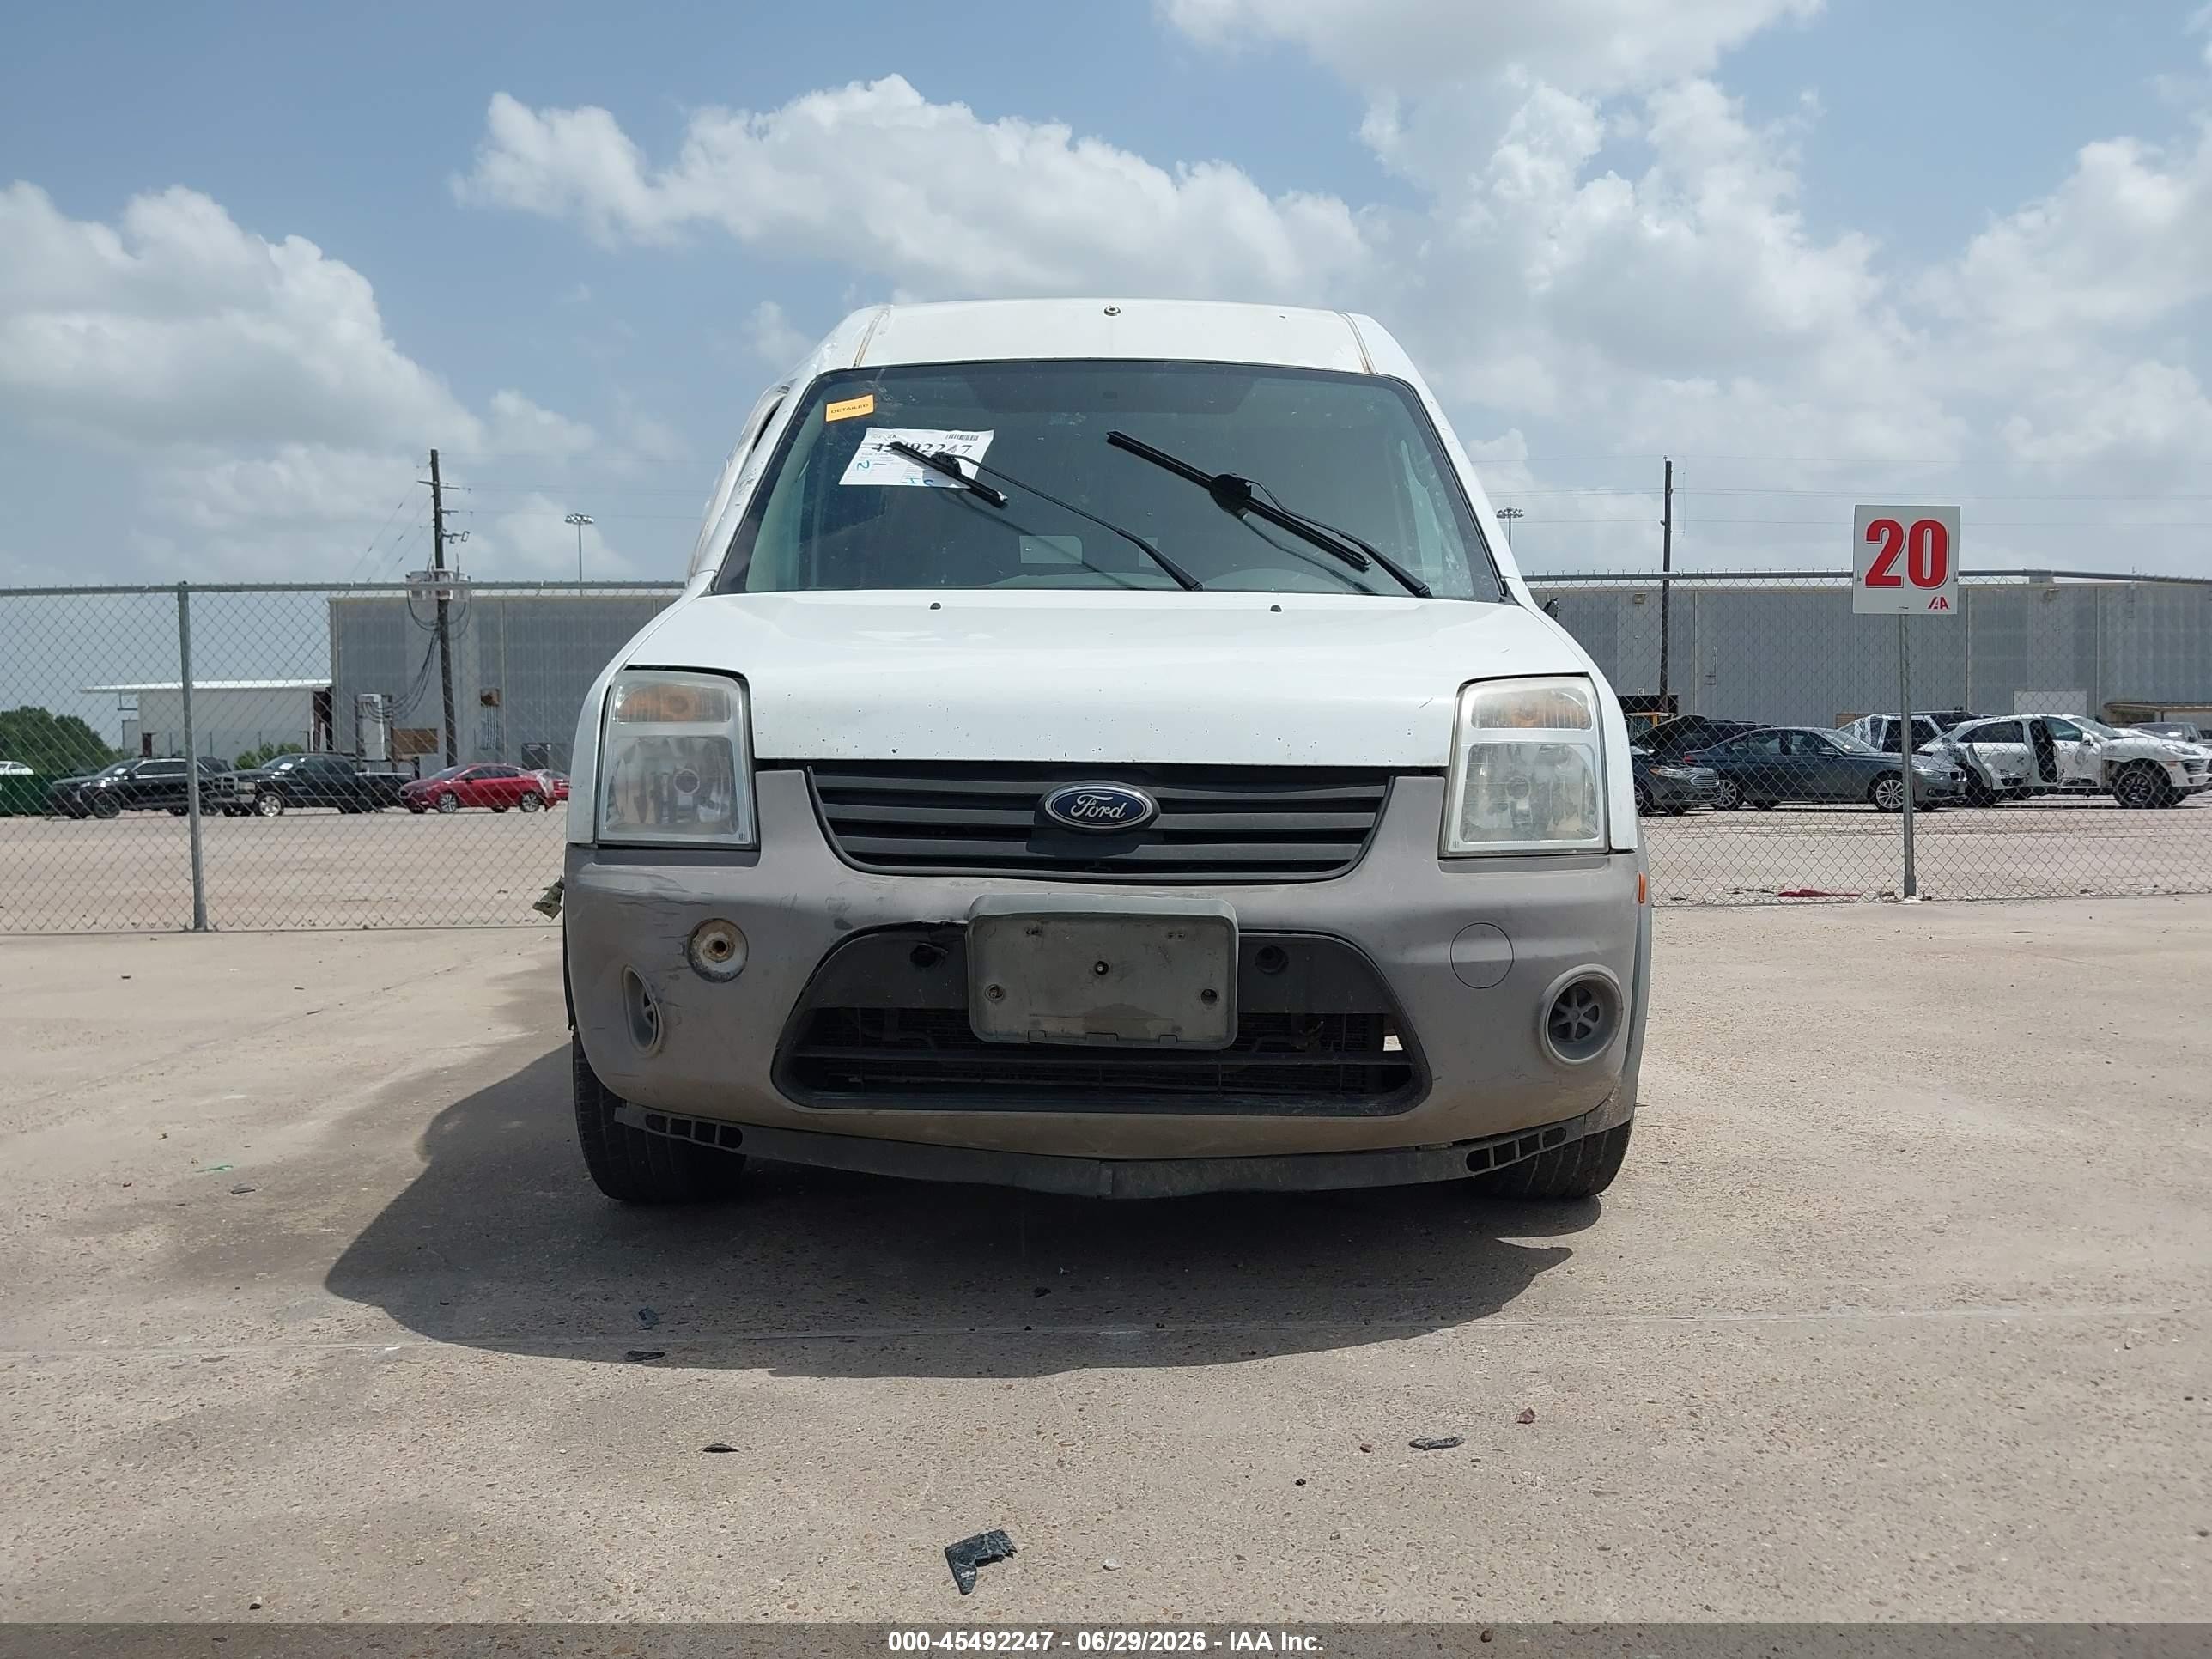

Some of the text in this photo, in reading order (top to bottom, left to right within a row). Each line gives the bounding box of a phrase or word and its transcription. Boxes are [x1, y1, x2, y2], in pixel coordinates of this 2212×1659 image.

[830, 404, 869, 414] DETAILED
[1864, 518, 1950, 590] 20
[1070, 793, 1127, 818] Ford
